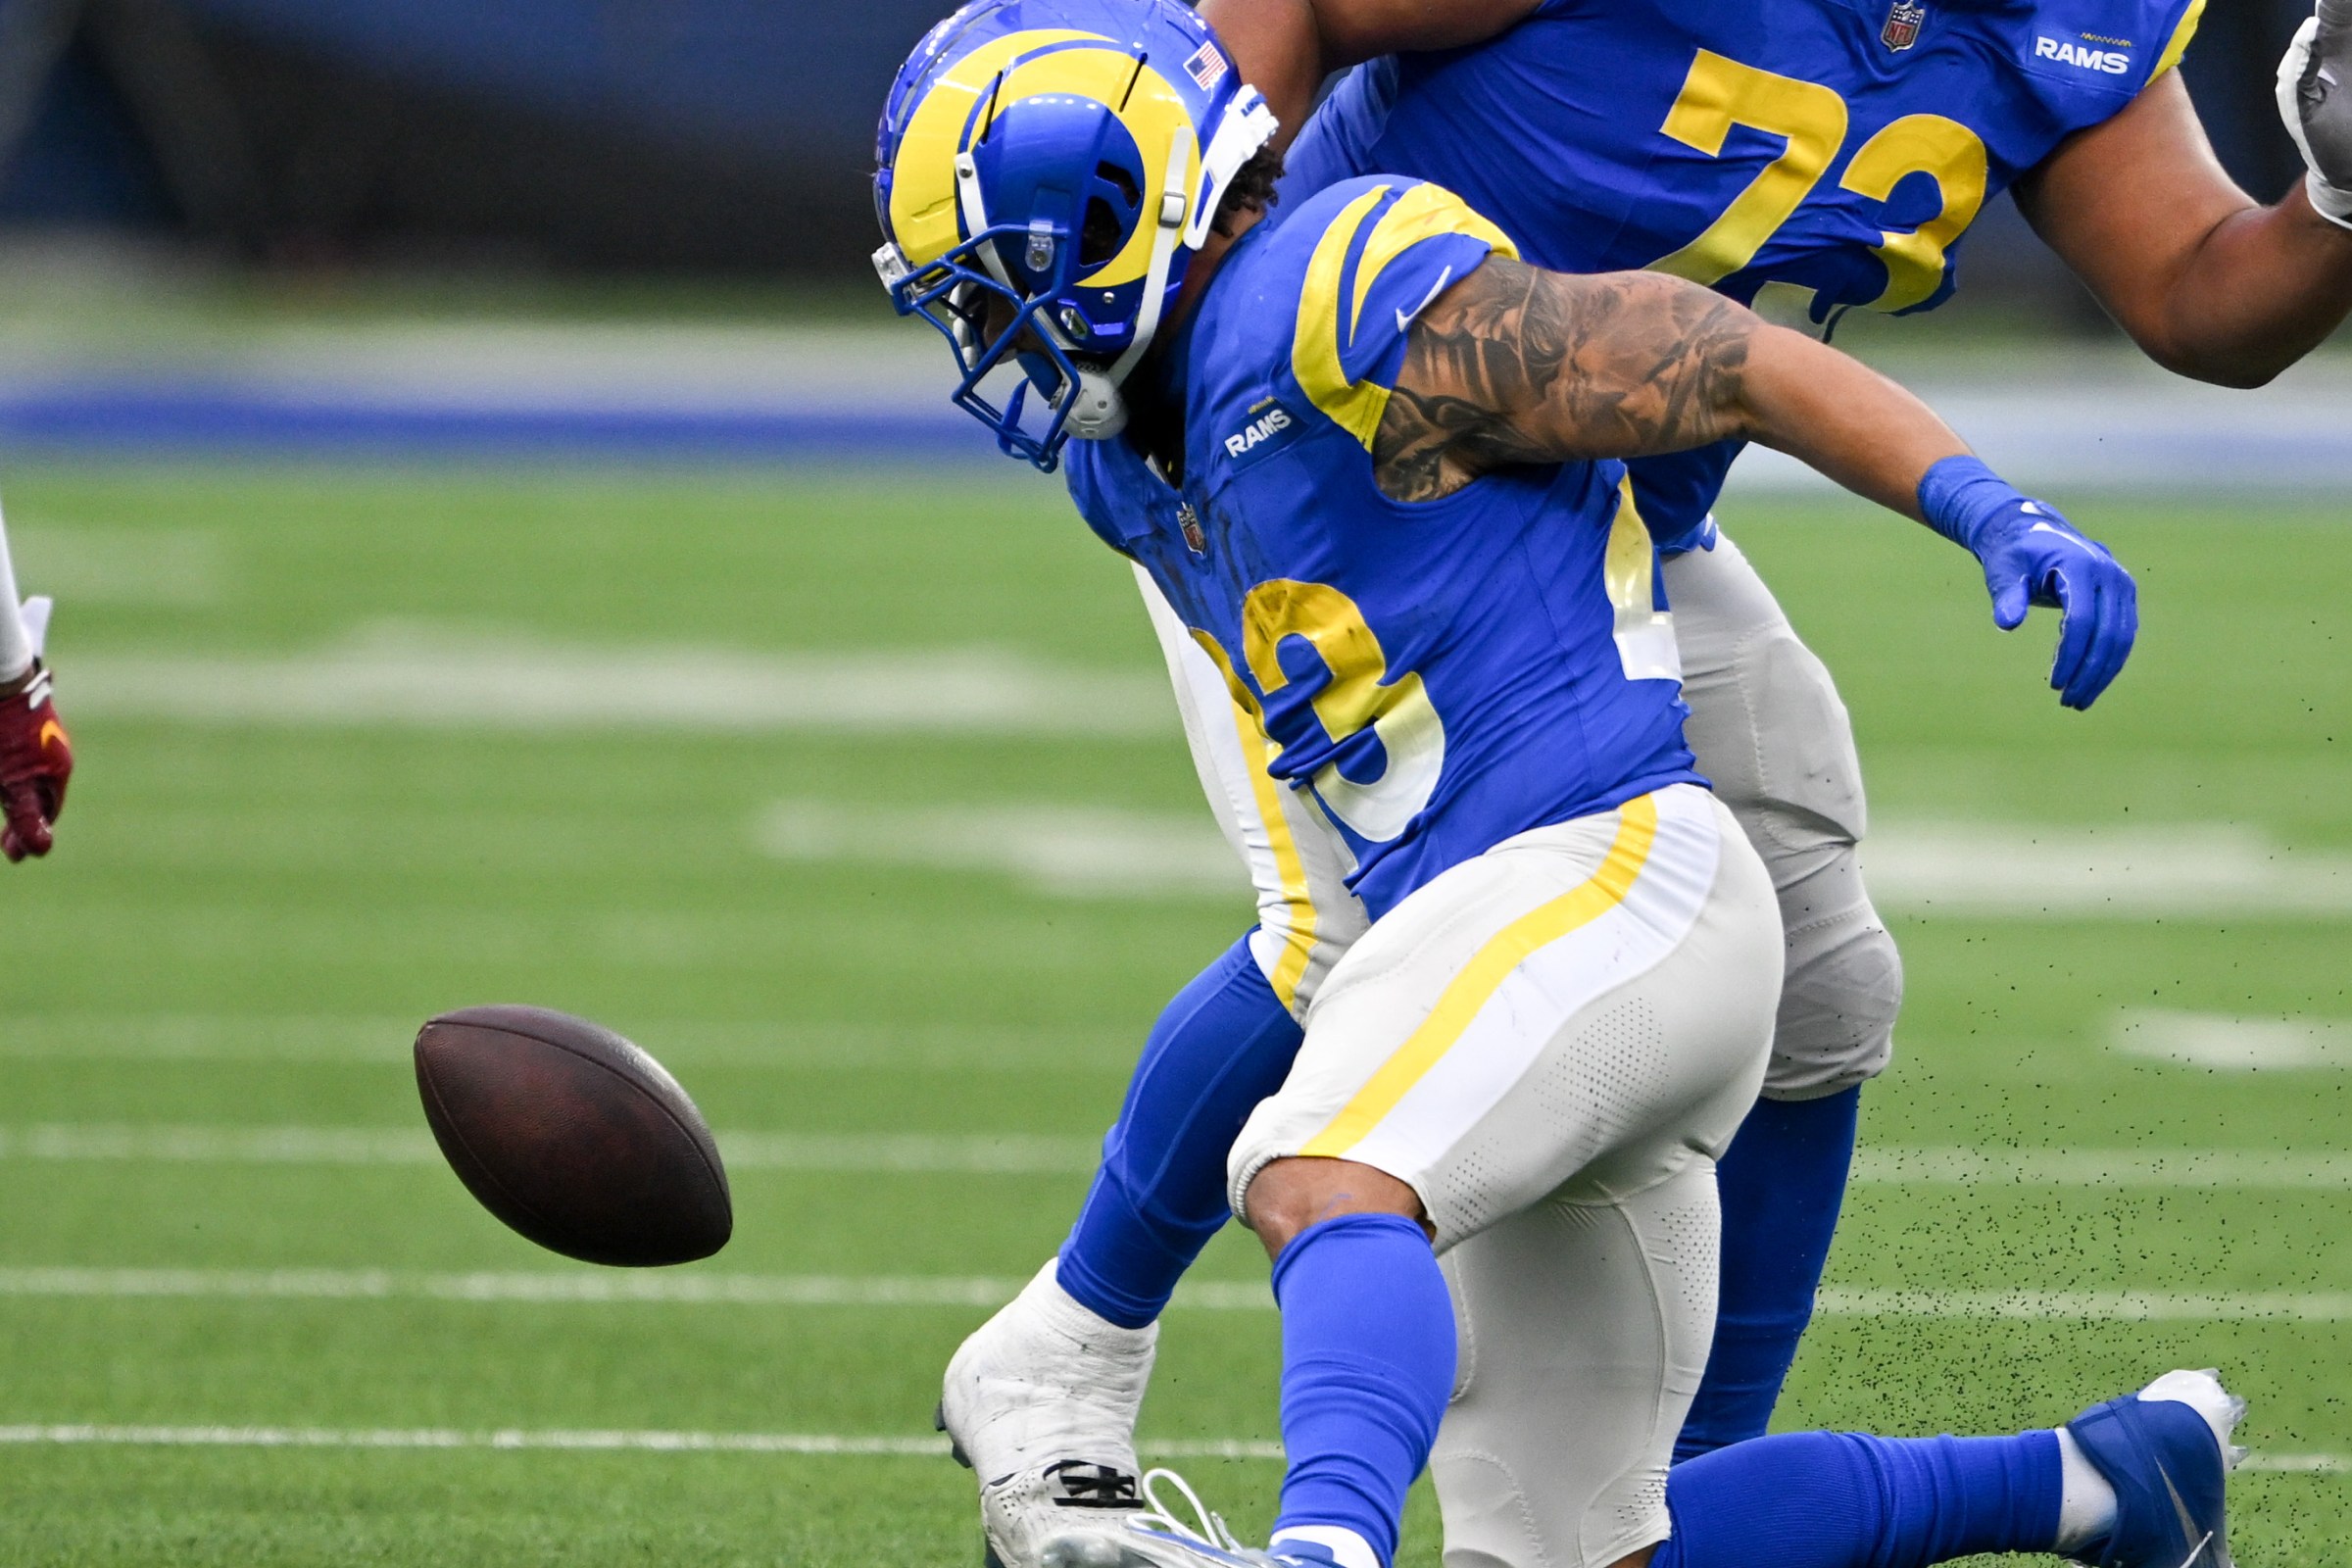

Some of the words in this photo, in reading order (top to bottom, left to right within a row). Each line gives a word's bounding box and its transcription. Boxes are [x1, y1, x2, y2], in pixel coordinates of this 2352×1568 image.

[2034, 35, 2131, 74] RAMS
[1641, 47, 1988, 339] 73
[1224, 409, 1292, 459] RAMS
